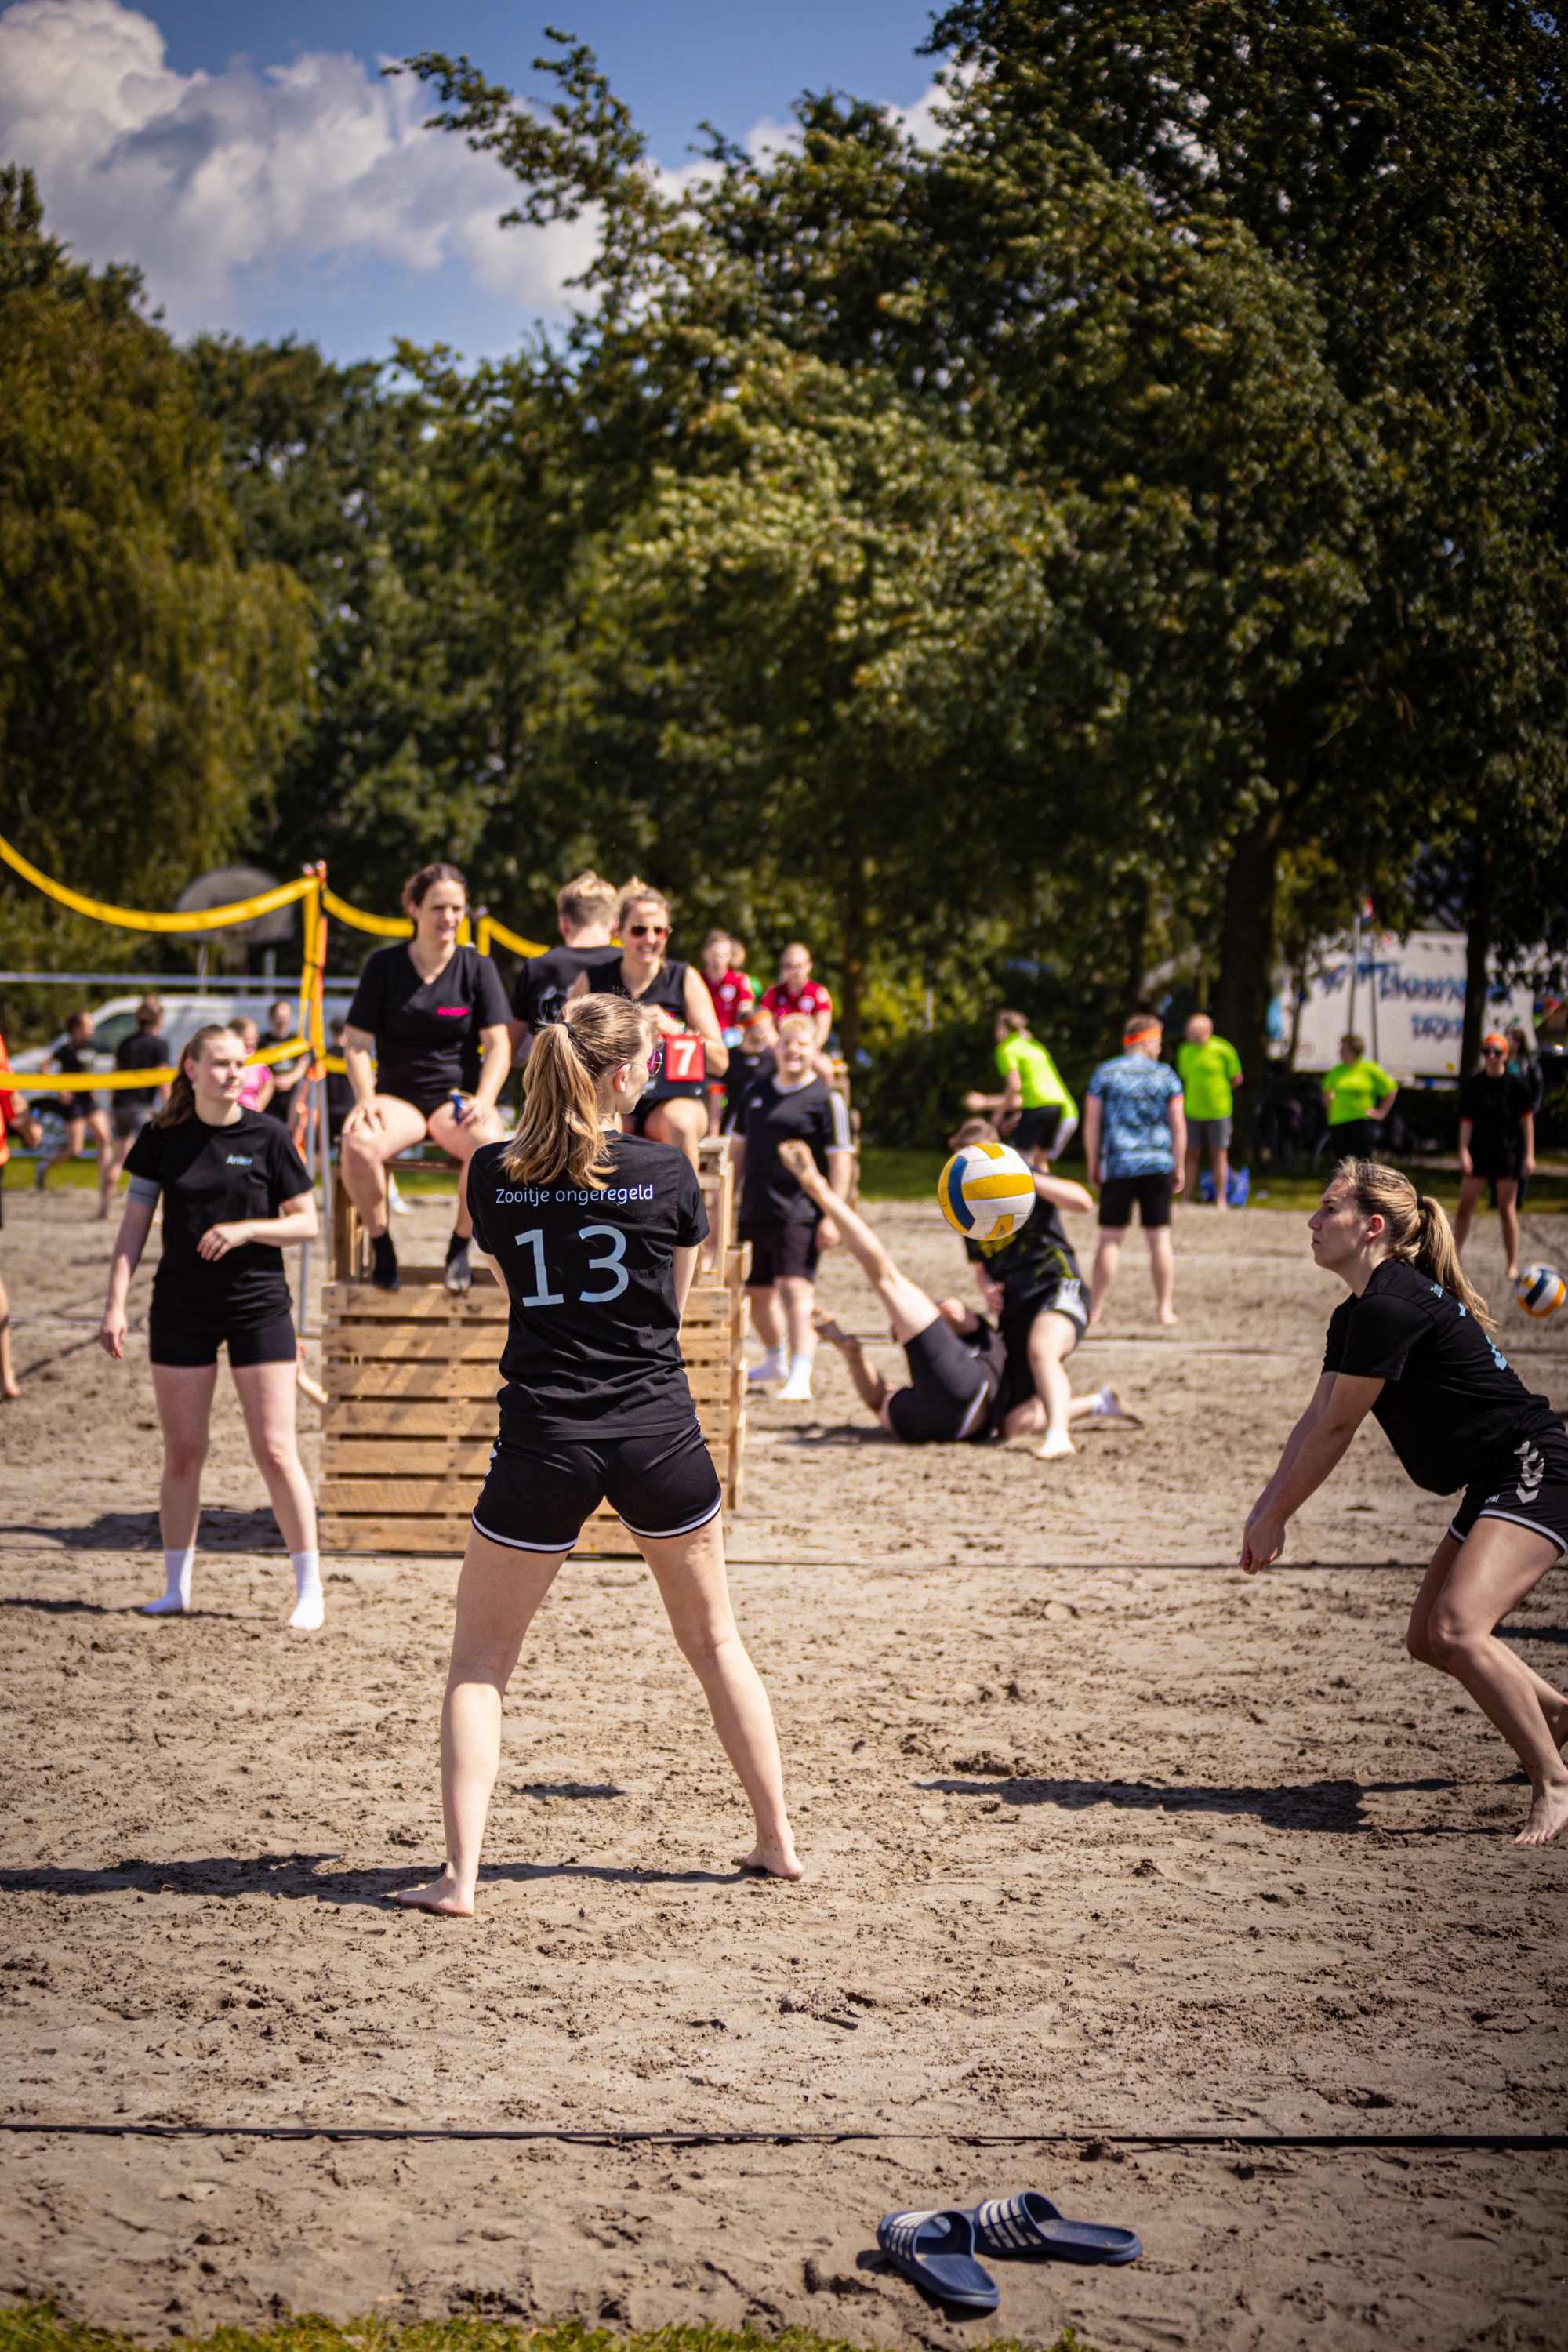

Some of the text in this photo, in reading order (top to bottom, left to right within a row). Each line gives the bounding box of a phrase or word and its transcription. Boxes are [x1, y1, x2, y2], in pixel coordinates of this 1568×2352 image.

[674, 1040, 696, 1076] 7
[495, 1184, 653, 1207] Zooitje ongeregeld
[514, 1225, 629, 1307] 13
